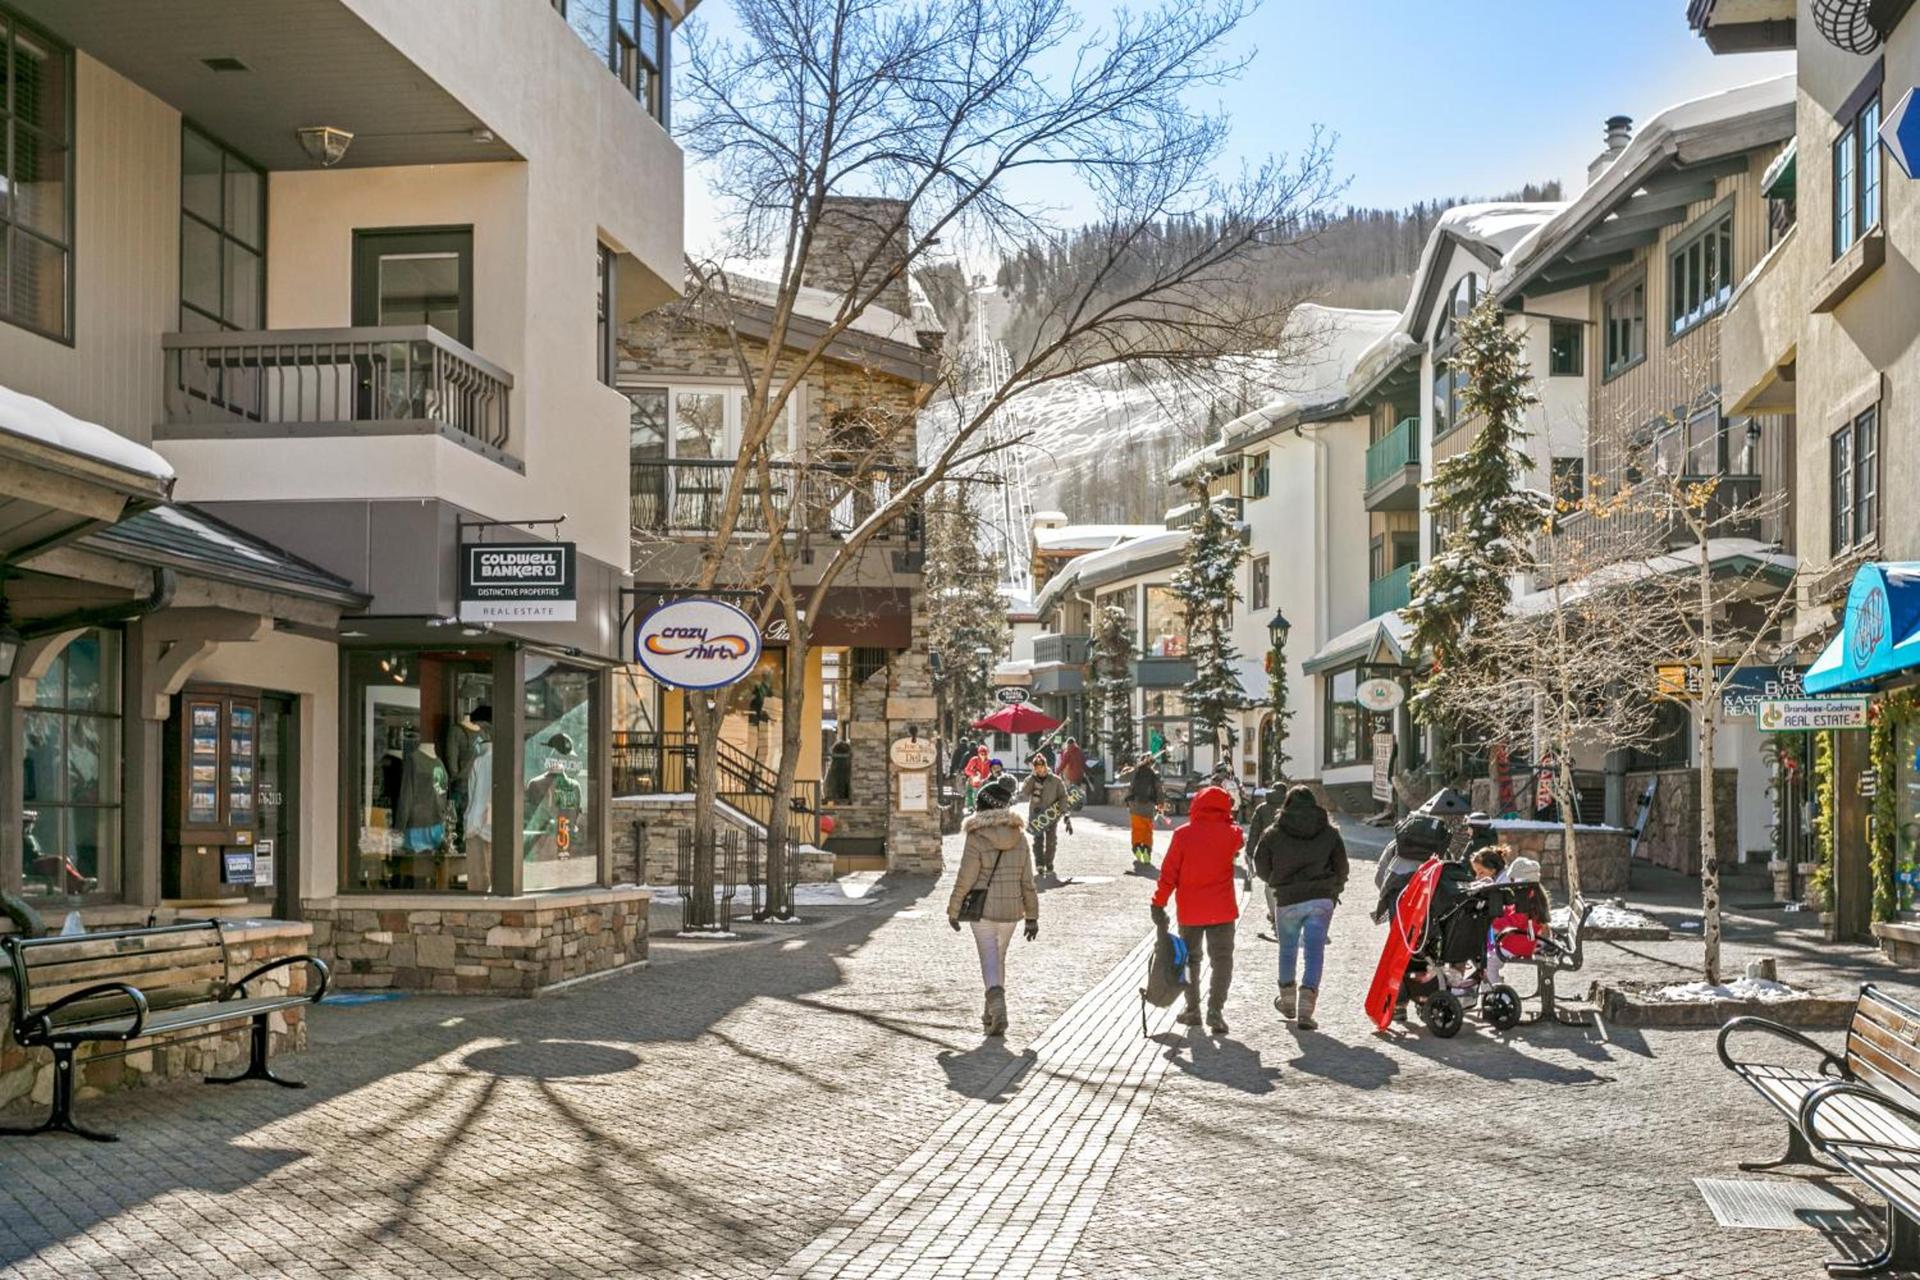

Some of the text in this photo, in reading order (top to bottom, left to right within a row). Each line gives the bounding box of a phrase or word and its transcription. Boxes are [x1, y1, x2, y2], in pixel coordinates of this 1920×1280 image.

[478, 588, 559, 596] DISTINCTIVE PROPERTIES
[483, 607, 553, 615] REAL ESTATE
[661, 627, 708, 641] crazy
[685, 645, 737, 659] shirts
[1784, 715, 1810, 726] REAL
[1814, 715, 1850, 726] ESTATE
